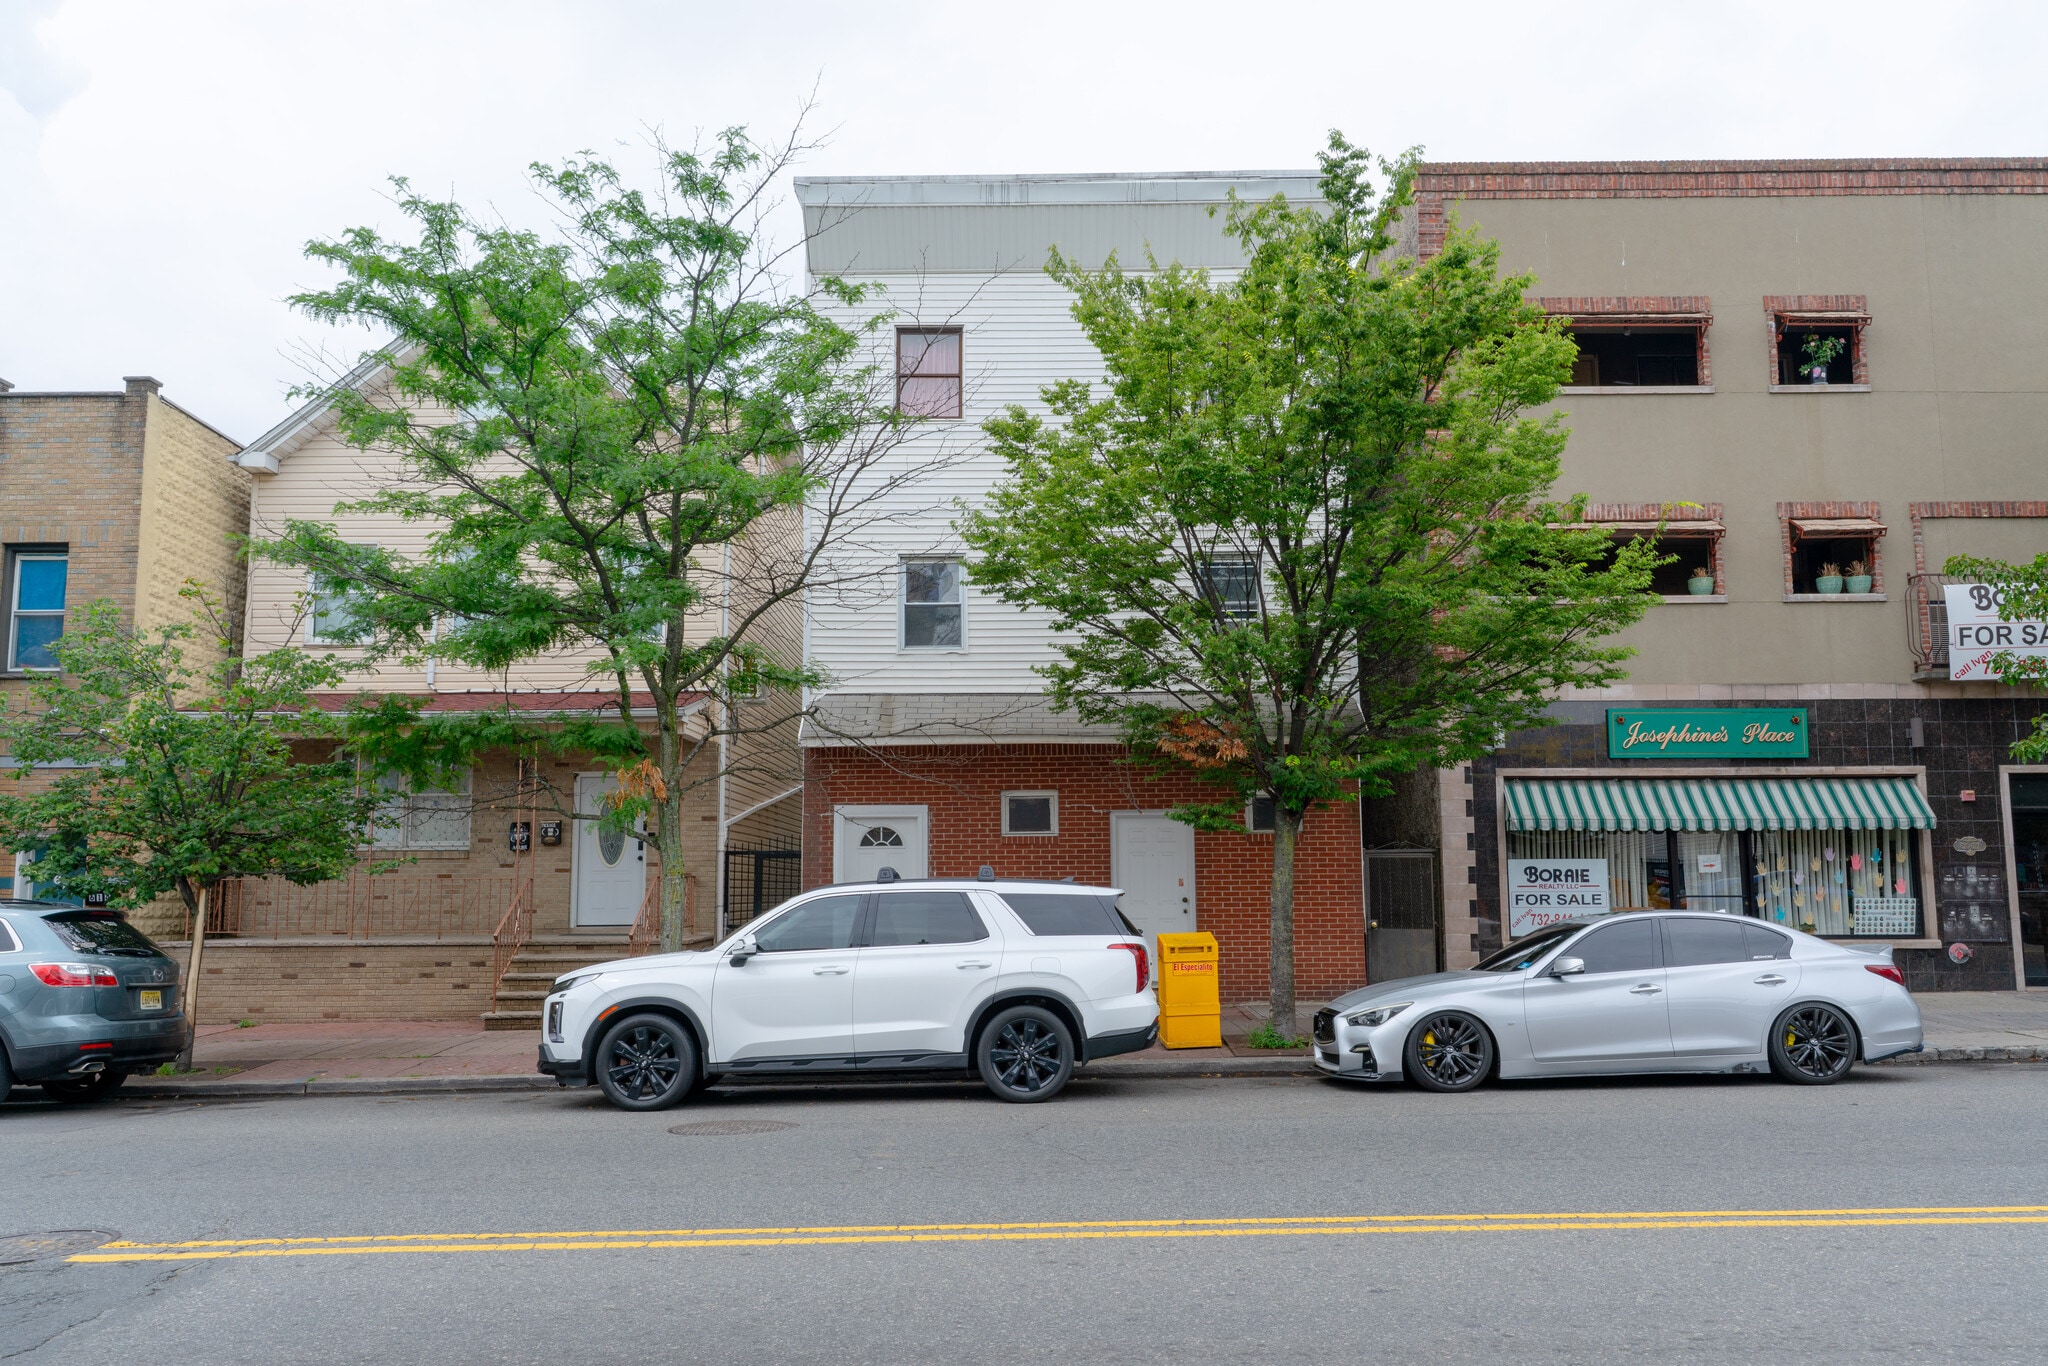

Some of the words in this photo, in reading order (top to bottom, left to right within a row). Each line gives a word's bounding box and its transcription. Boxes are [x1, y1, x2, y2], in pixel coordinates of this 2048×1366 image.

[1958, 625, 2013, 647] FOR
[1954, 663, 1972, 680] call
[1970, 650, 1993, 667] Ivan
[1622, 721, 1729, 750] Josephine's
[1741, 722, 1795, 744] Place
[1523, 866, 1590, 883] BORAIE
[1515, 894, 1551, 905] FOR
[1556, 893, 1602, 905] SALE
[1512, 916, 1521, 928] call
[1173, 963, 1180, 971] El
[1180, 963, 1213, 972] Especialito
